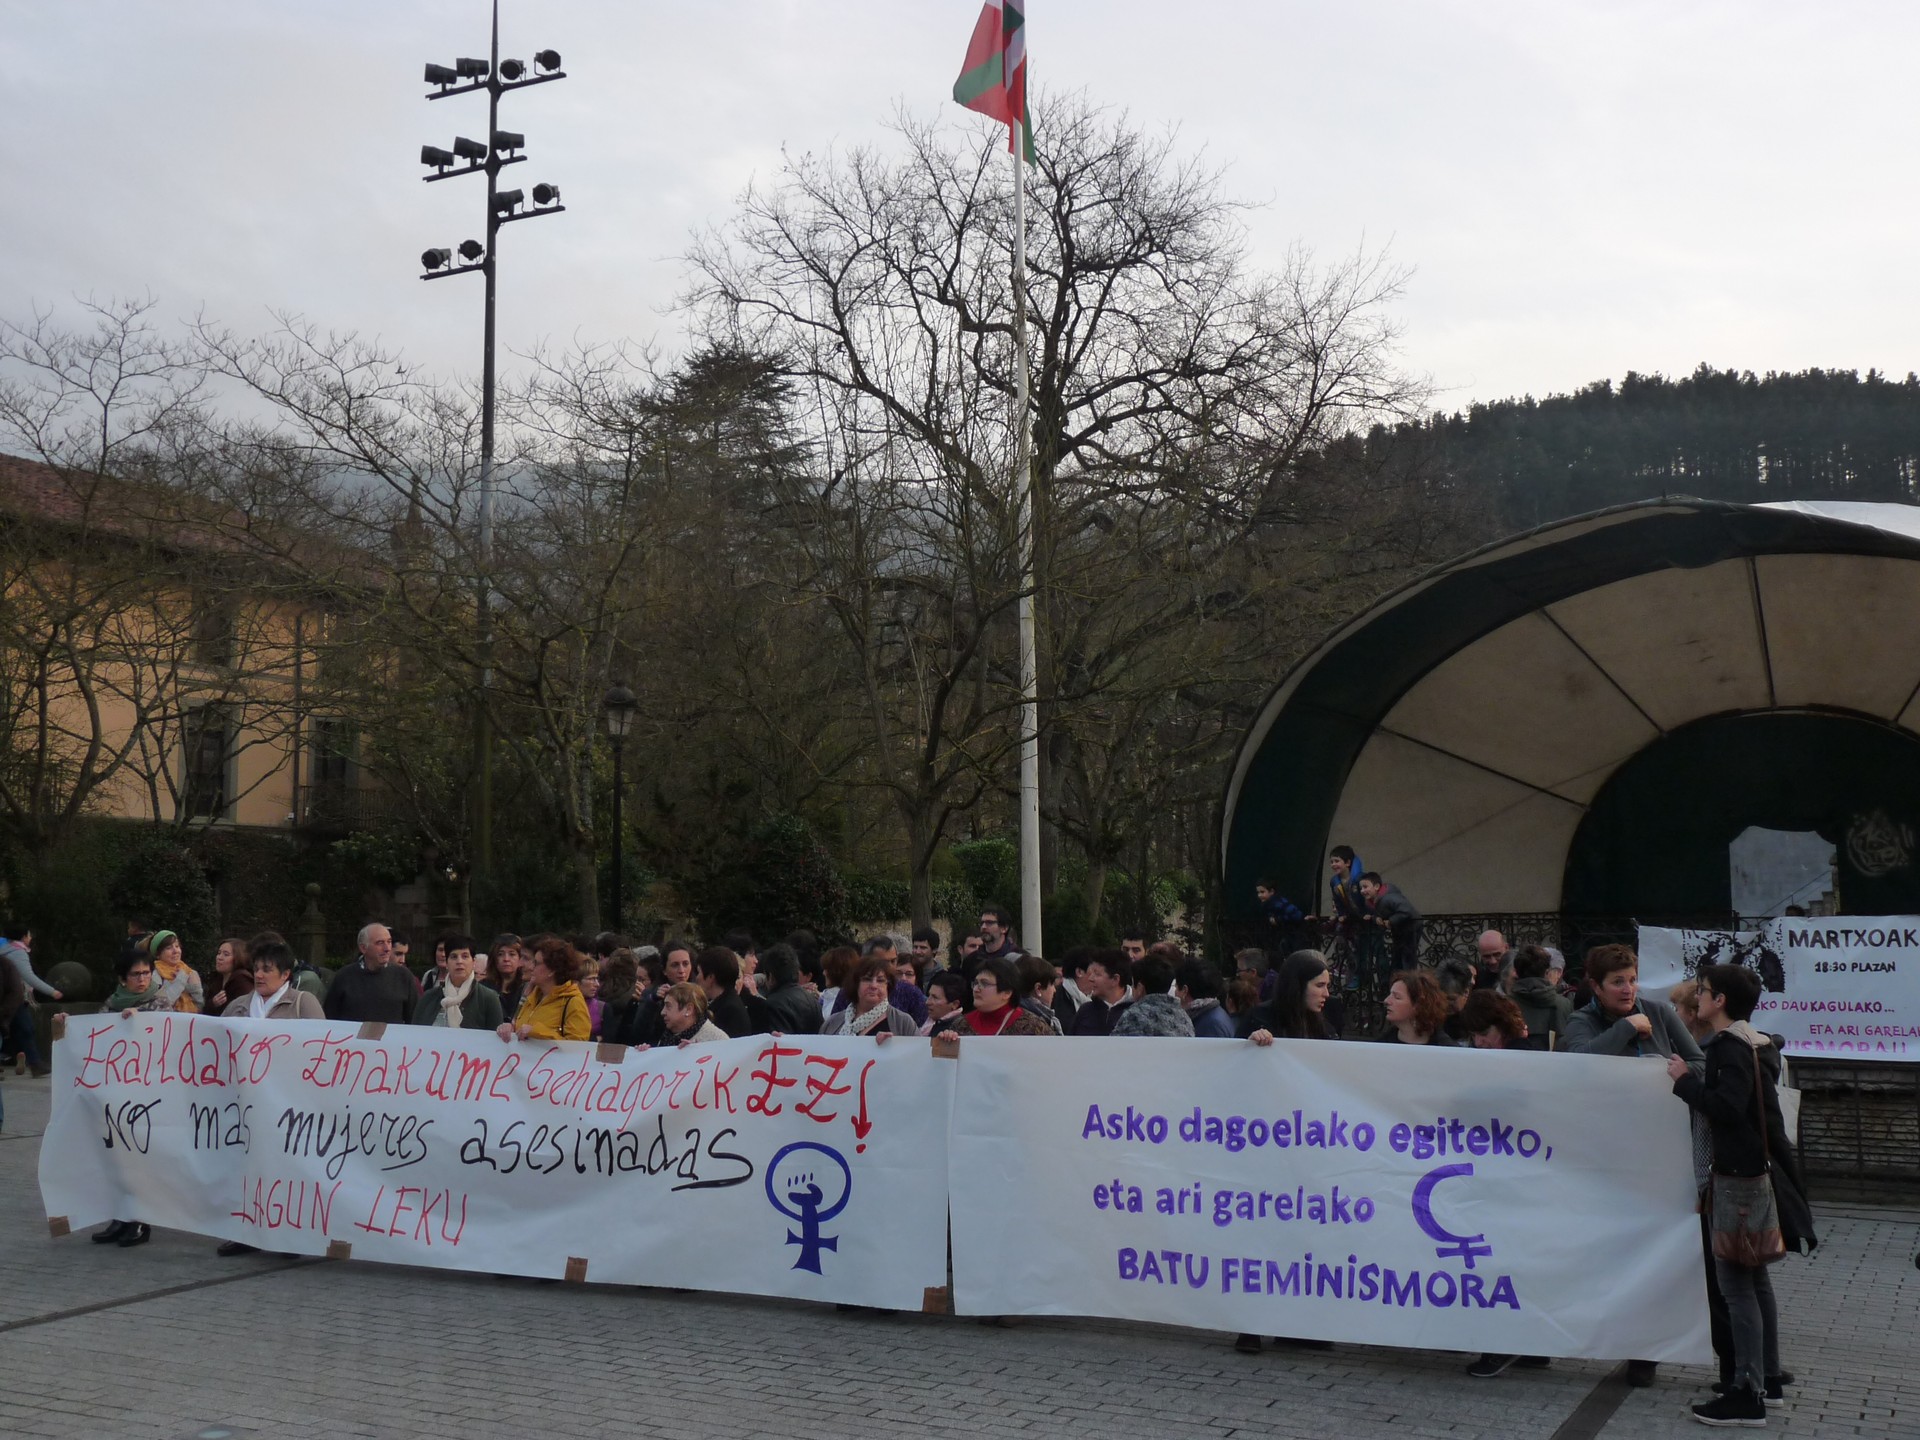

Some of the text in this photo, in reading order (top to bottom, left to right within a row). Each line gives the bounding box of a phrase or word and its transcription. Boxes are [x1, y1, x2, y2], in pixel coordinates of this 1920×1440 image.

[1788, 928, 1919, 949] MARTXOAK
[1814, 961, 1896, 973] 18:30 PLAZAN
[1809, 1024, 1833, 1034] ETA
[1837, 1025, 1859, 1036] ARI
[278, 1105, 434, 1180] mujeres
[460, 1114, 754, 1191] asesinadas
[1081, 1104, 1553, 1160] Asko dagoelako egiteko,
[231, 1176, 467, 1246] LAGUN LEKU
[1092, 1178, 1375, 1227] eta ari garelako
[1117, 1247, 1210, 1289] BATU
